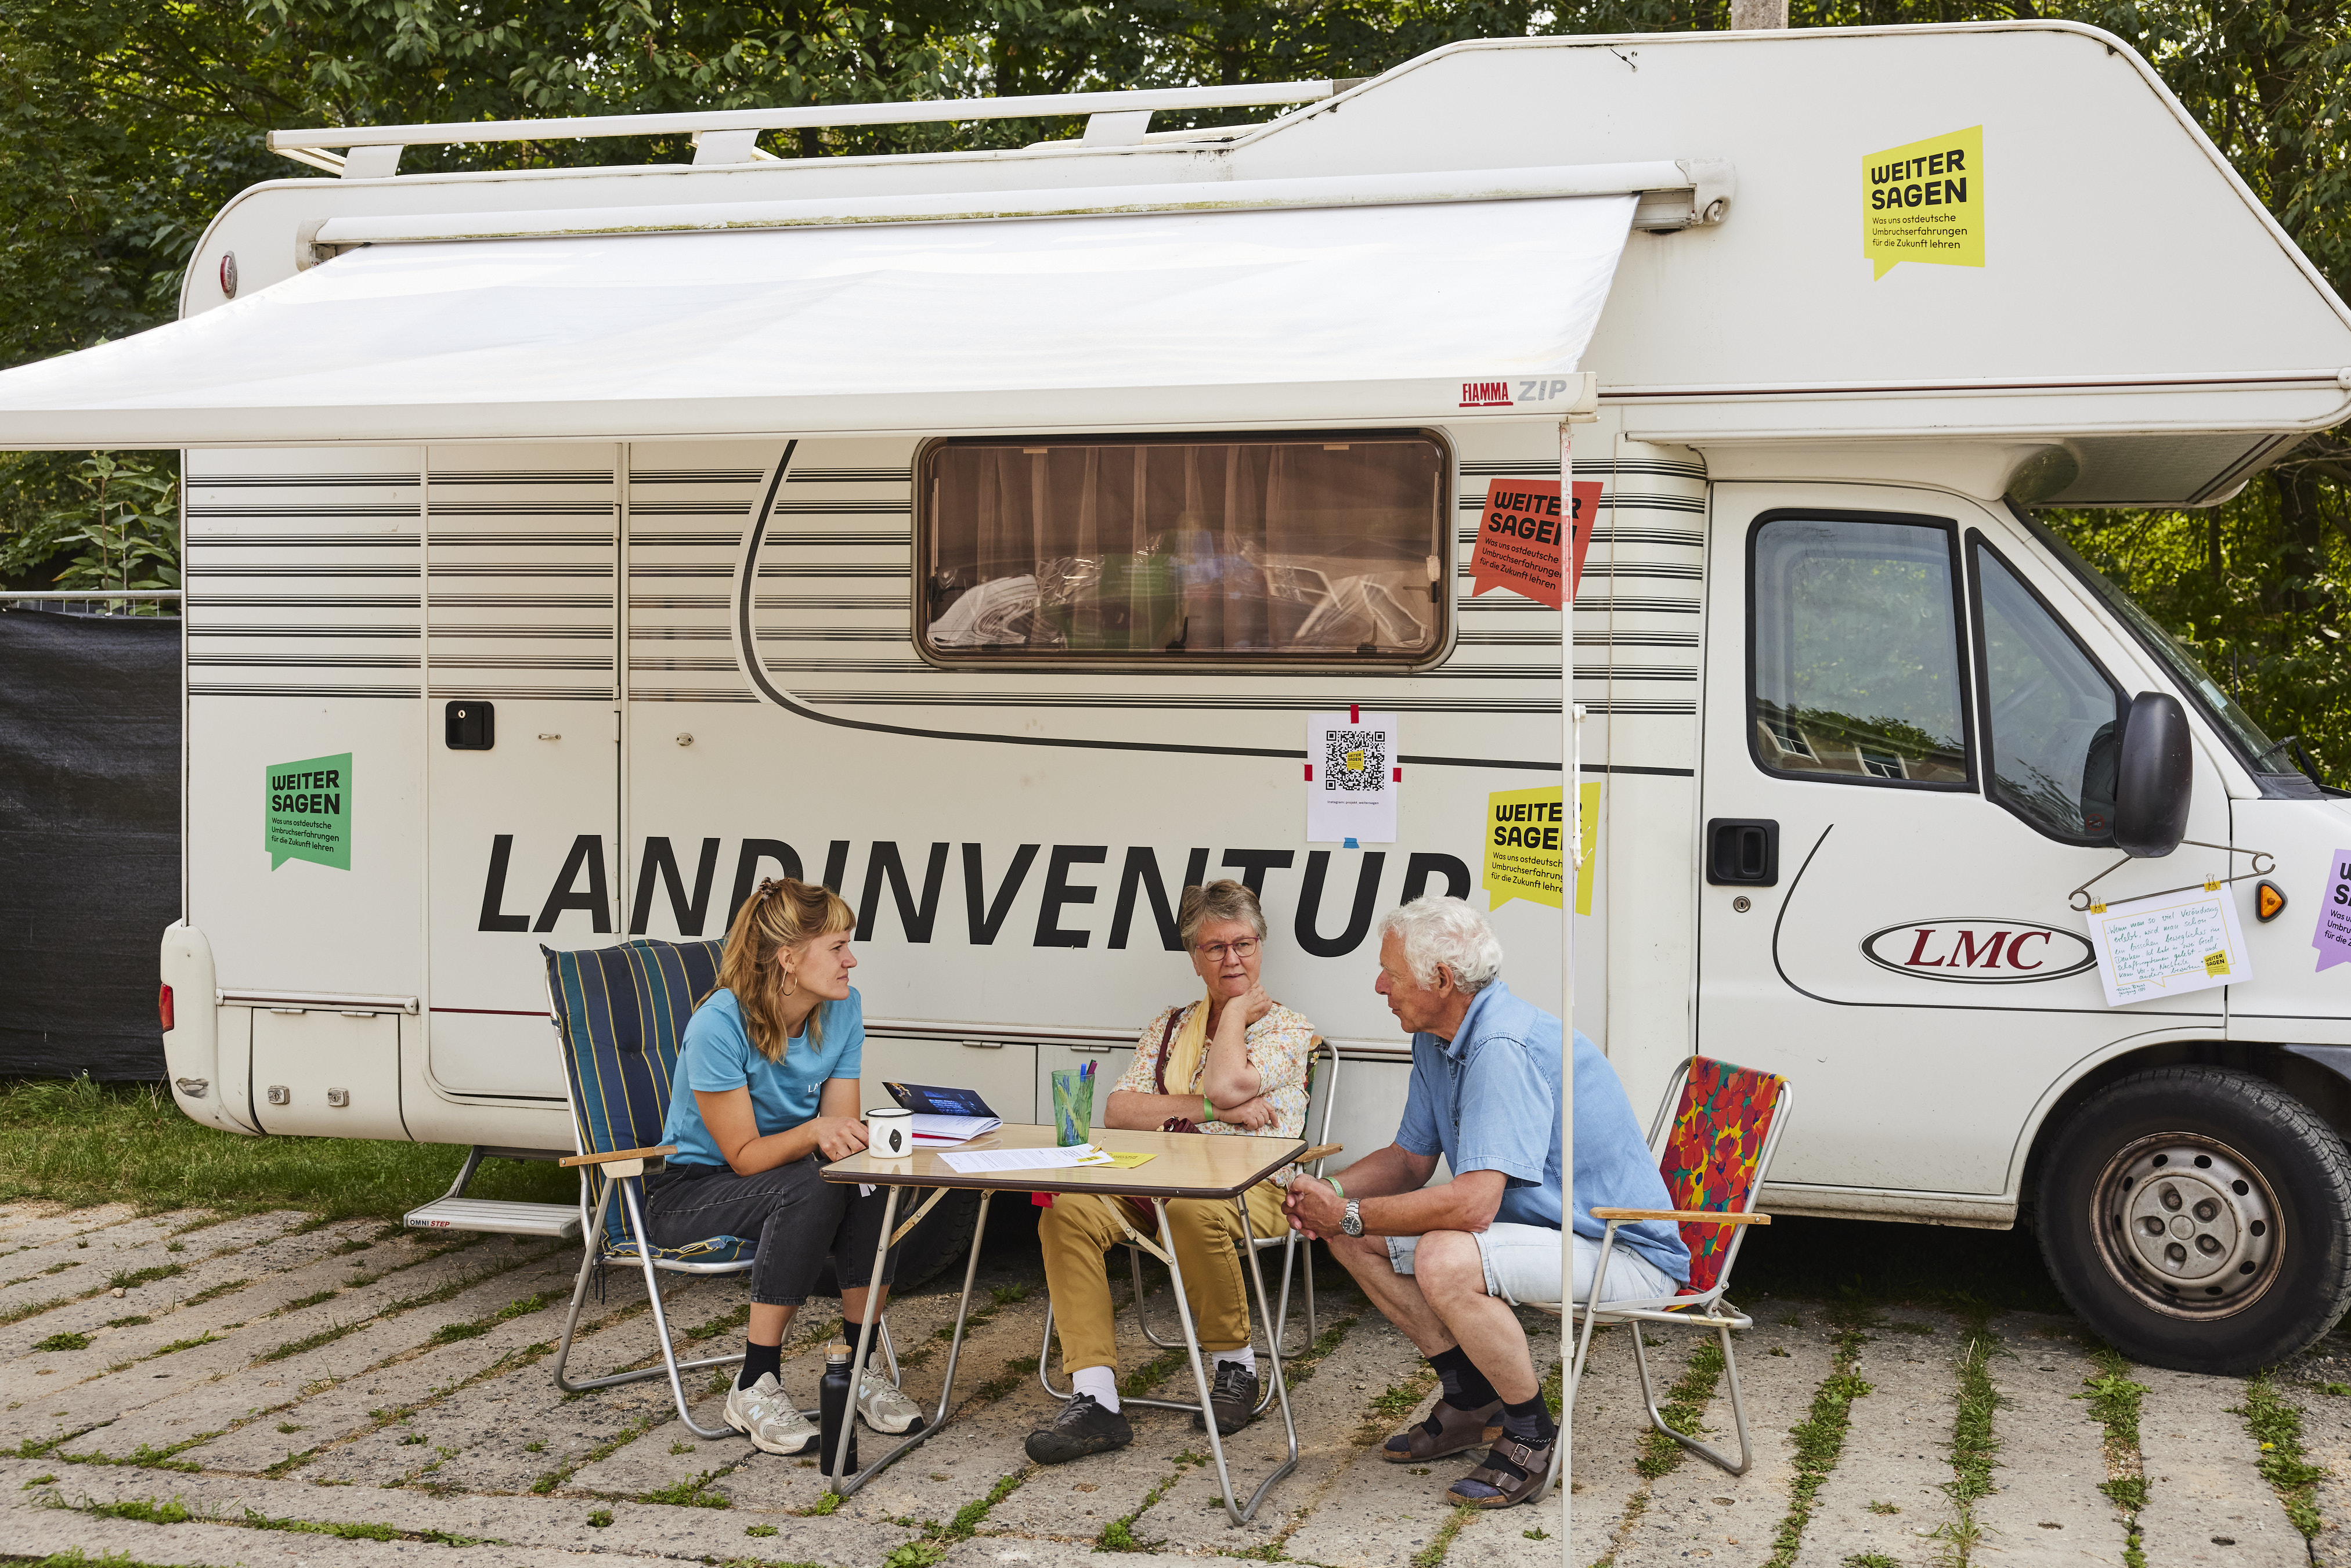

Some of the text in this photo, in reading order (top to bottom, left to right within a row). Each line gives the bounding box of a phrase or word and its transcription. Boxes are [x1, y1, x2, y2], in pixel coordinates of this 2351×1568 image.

[1872, 149, 1965, 185] WEITER
[1872, 178, 1967, 209] SAGEN
[1903, 214, 1956, 223] ostdeutsche
[1873, 227, 1967, 237] Umbruchserfahrungen
[1897, 239, 1927, 247] Zukunft
[1930, 240, 1960, 248] lehren
[1462, 380, 1567, 402] FIAMMA ZIP
[1485, 537, 1559, 563] Was uns ostdeutsche
[1479, 558, 1555, 590] für die Zukunft lehren
[272, 769, 340, 791] WEITER
[272, 793, 340, 814] SAGEN
[294, 820, 331, 829] ostdeutsche
[272, 827, 339, 842] Umbruchserfahrungen
[1494, 826, 1582, 851] SAGE
[289, 838, 310, 848] Zukunft
[312, 841, 334, 852] lehren
[1493, 852, 1506, 860] Was
[1520, 857, 1562, 868] ostdeutsch
[1492, 862, 1563, 883] Umbruchserfahrun
[1513, 876, 1541, 888] Zukunft
[1543, 881, 1563, 893] lehre
[2162, 912, 2173, 921] viel
[2331, 909, 2344, 920] Was
[2145, 926, 2158, 934] wird
[2327, 920, 2351, 934] Umbru
[2325, 930, 2335, 939] für
[2336, 935, 2347, 944] die
[1904, 929, 2052, 970] LMC
[749, 1404, 764, 1421] N
